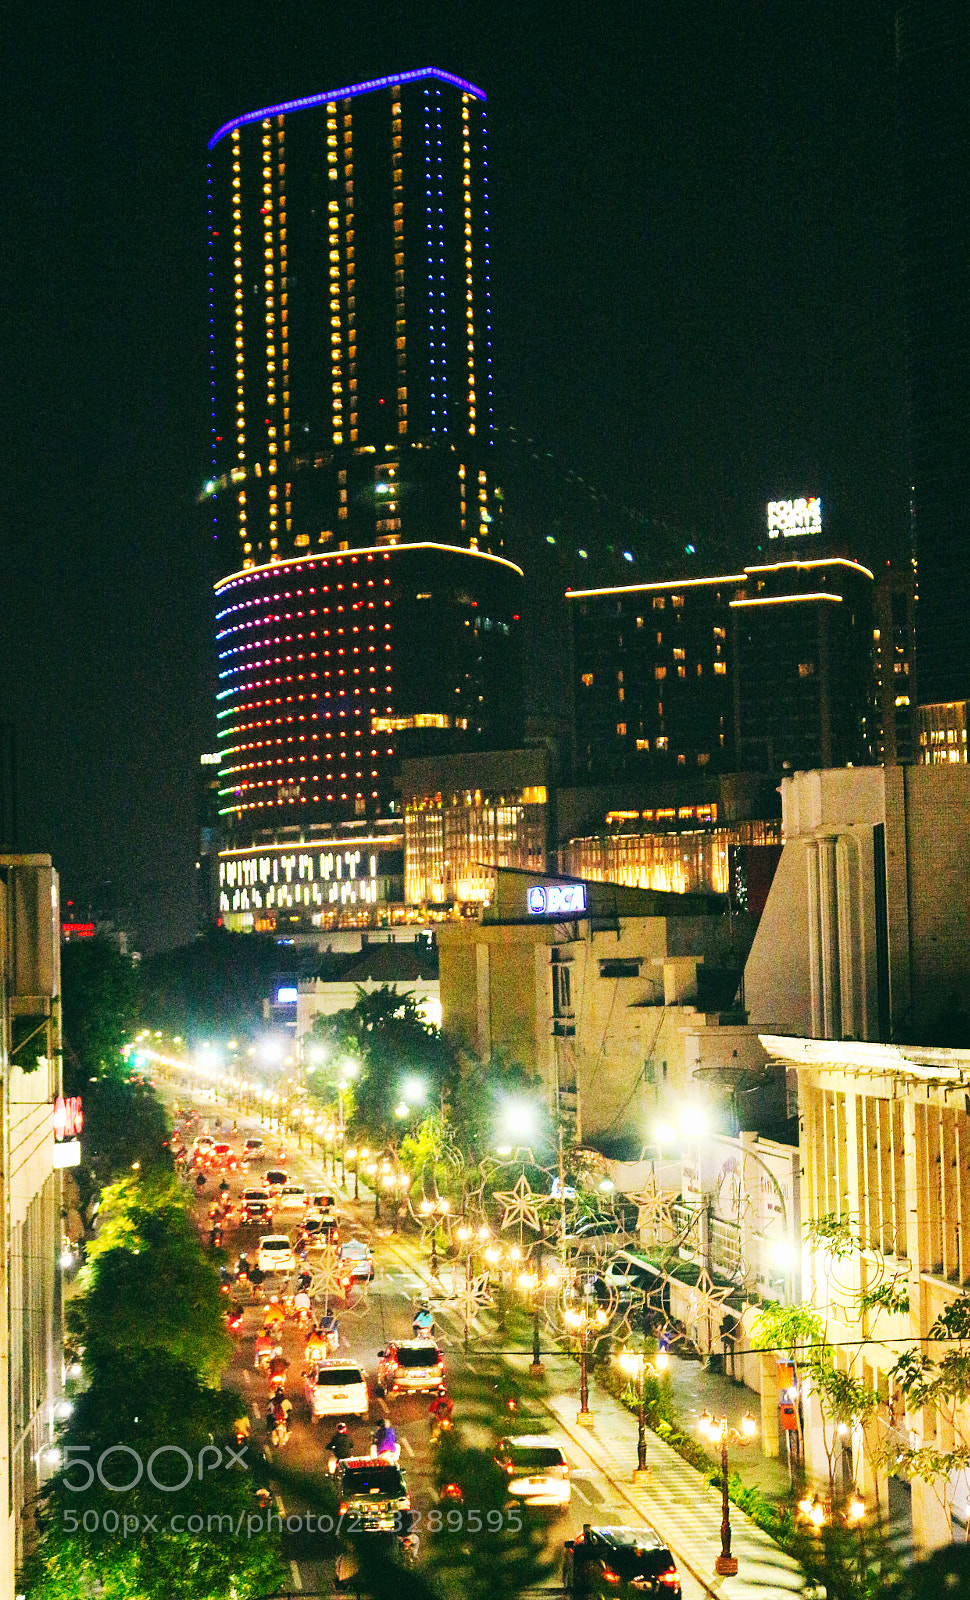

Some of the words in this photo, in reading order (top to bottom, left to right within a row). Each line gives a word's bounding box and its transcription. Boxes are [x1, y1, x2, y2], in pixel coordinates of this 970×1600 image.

[768, 498, 808, 516] FOUR
[768, 510, 822, 531] POINTS
[547, 885, 585, 913] BCA
